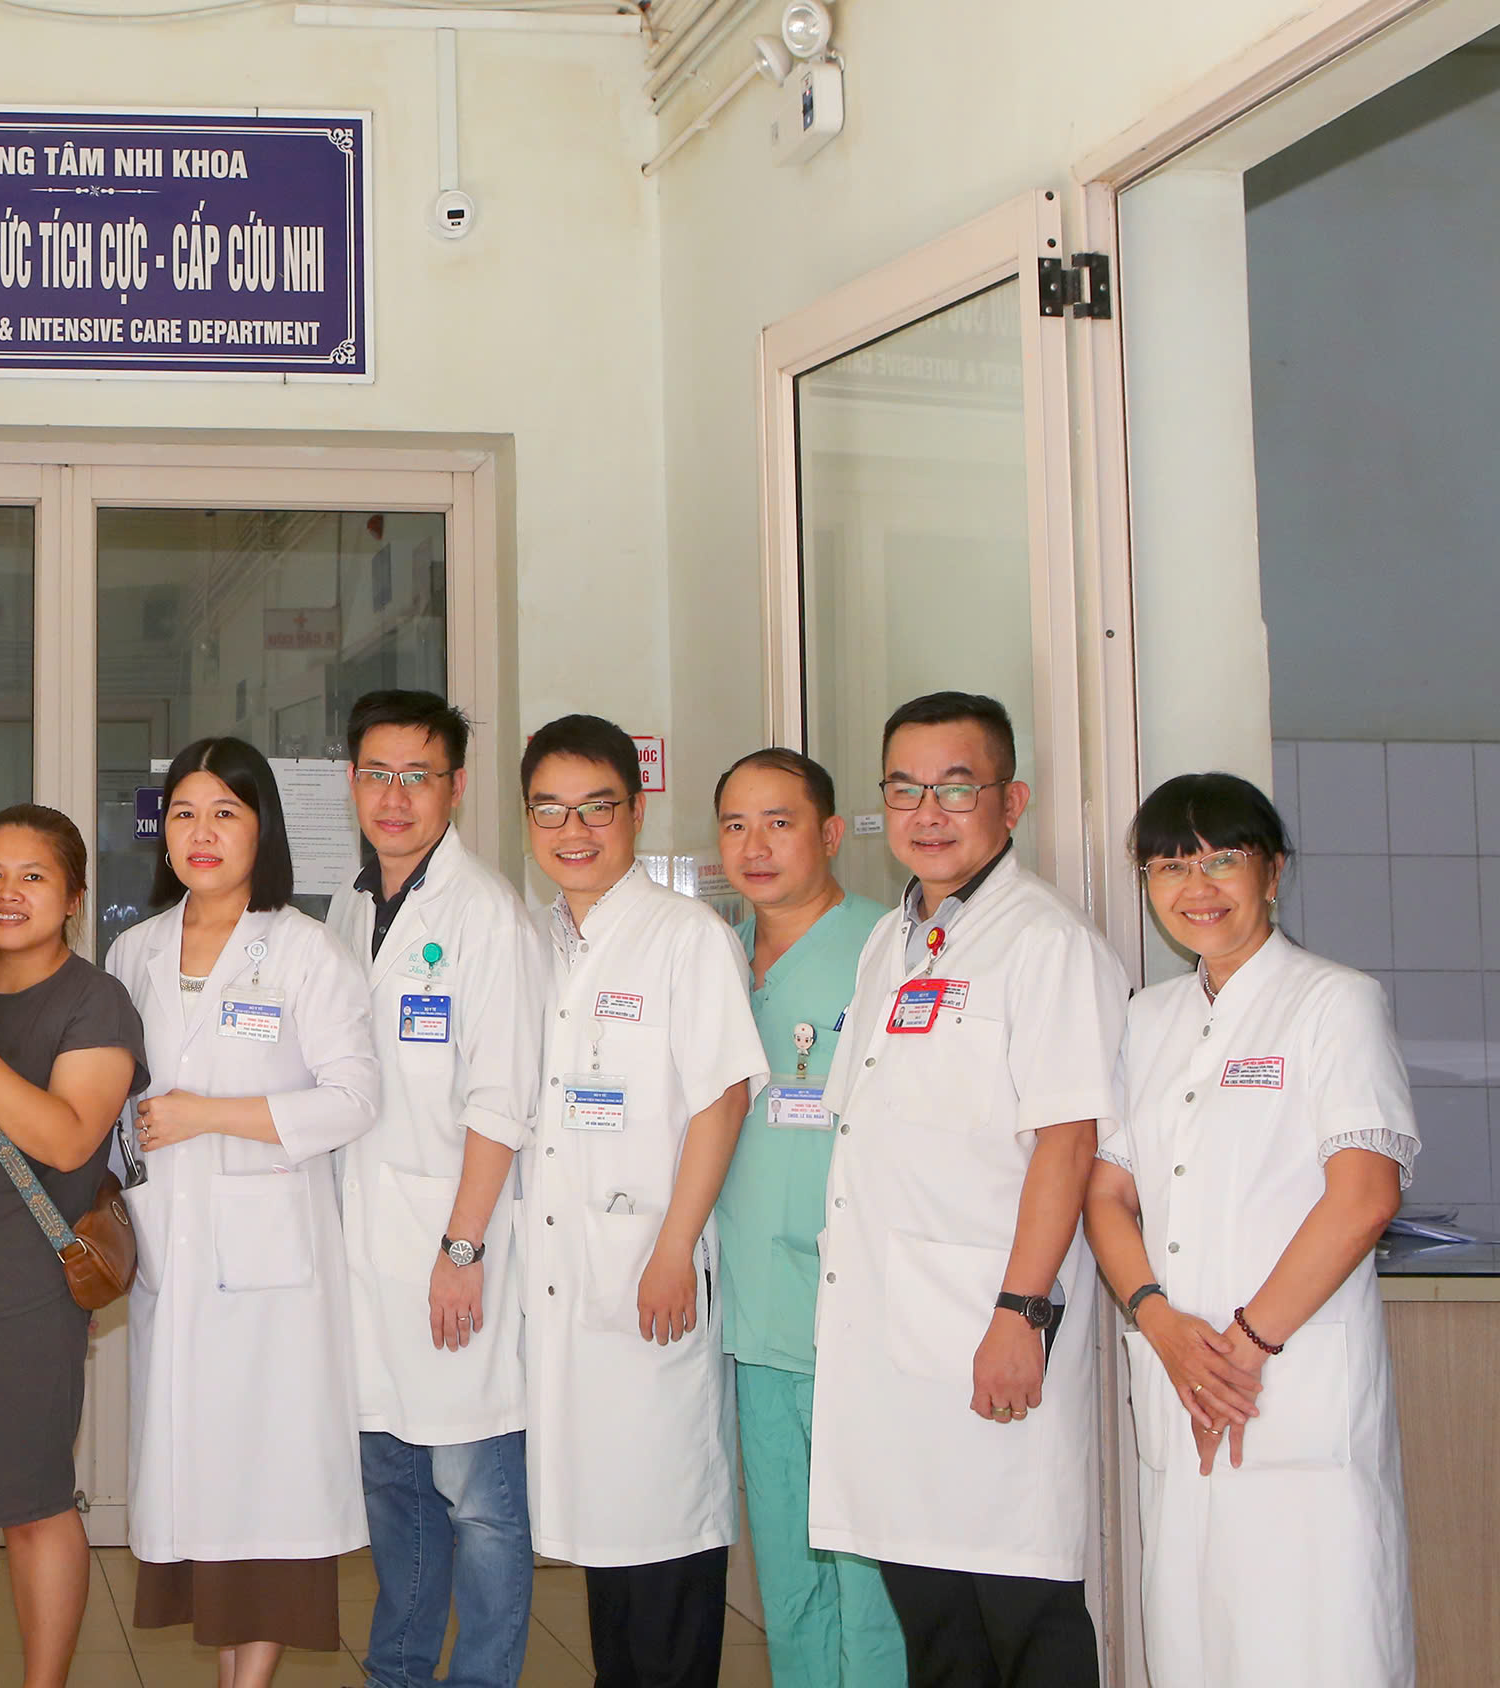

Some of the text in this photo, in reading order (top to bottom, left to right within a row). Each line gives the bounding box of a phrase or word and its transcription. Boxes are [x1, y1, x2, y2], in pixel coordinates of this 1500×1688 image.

[43, 141, 105, 177] TÂM
[114, 148, 163, 177] NHI
[172, 149, 248, 179] KHOA
[38, 207, 92, 289] TÍCH
[100, 216, 148, 305] CỰC
[155, 255, 165, 269] -
[172, 200, 220, 291] CẤP
[228, 210, 276, 292] CỨU
[283, 226, 325, 292] NHI
[20, 317, 124, 343] INTENSIVE
[130, 318, 182, 343] CARE
[188, 319, 320, 346] DEPARTMENT
[136, 818, 158, 833] XIN
